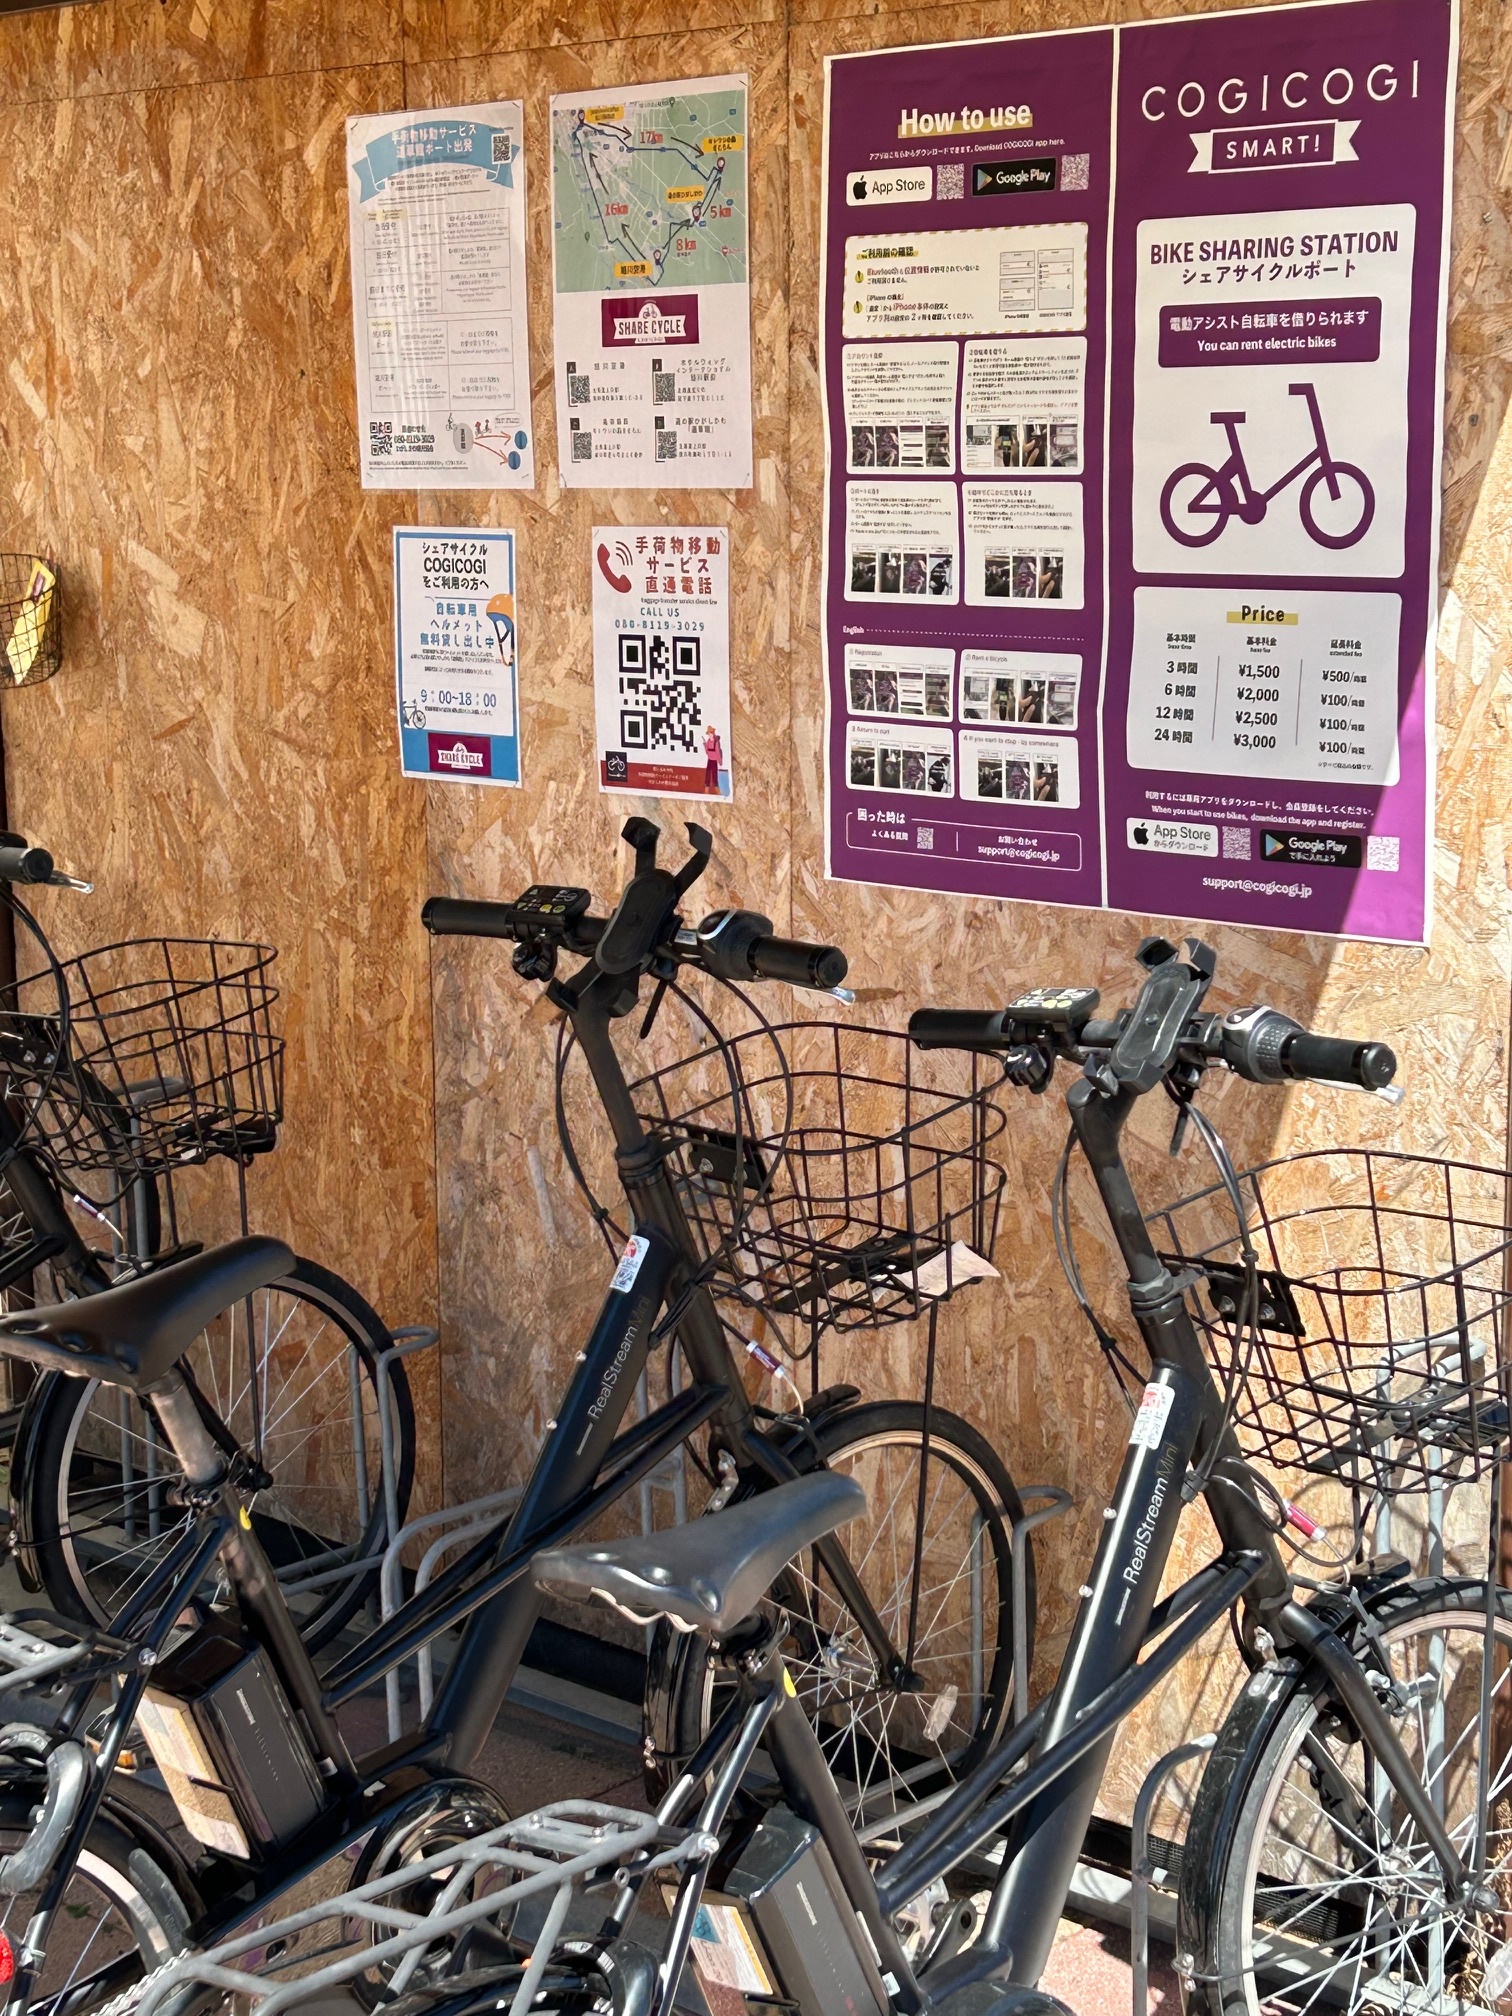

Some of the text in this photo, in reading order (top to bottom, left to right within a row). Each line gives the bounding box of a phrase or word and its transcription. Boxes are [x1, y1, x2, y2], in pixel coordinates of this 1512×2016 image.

[1141, 59, 1419, 121] COGICOGI
[900, 103, 1031, 135] How to use
[1225, 133, 1320, 160] SMART!
[995, 168, 1051, 186] Google Play
[871, 178, 926, 195] App Store
[1150, 230, 1399, 265] BIKE SHARING STATION
[1181, 258, 1356, 285] シェアサイクルポート
[1169, 309, 1369, 332] 電動アシスト自転車を借りられます
[1197, 335, 1337, 352] You can rent electric bikes
[422, 542, 488, 556] シェアサイクル
[635, 535, 720, 555] 手荷物移動
[423, 557, 487, 574] COGICOGI
[646, 556, 709, 574] サービス
[422, 575, 489, 591] をご利用の方へ
[645, 575, 712, 595] 直通電話
[436, 601, 477, 617] 自転車用
[640, 607, 680, 618] CALL US
[1240, 605, 1285, 622] Price
[430, 619, 483, 632] ヘルメット
[614, 619, 705, 631] 080-8119-3029
[420, 632, 495, 649] 無料貸し出し中
[1238, 664, 1280, 680] ¥1,500
[1236, 687, 1280, 704] ¥2,000
[1235, 710, 1278, 726] ¥2,500
[1233, 733, 1277, 750] ¥3,000
[1151, 805, 1172, 814] When
[1172, 808, 1186, 816] you
[1186, 808, 1204, 817] start
[1204, 810, 1212, 818] to
[1250, 813, 1287, 824] download
[1288, 816, 1300, 825] the
[1301, 818, 1317, 828] app
[1317, 819, 1333, 827] and
[1333, 820, 1367, 830] register.
[1153, 824, 1211, 841] App Store
[977, 845, 1060, 862] support@cogicogi.jp
[1288, 837, 1348, 855] Google Play
[1202, 875, 1313, 899] support@cogicogi.jp
[587, 1324, 639, 1420] RealStream
[1122, 1476, 1170, 1585] RealStream
